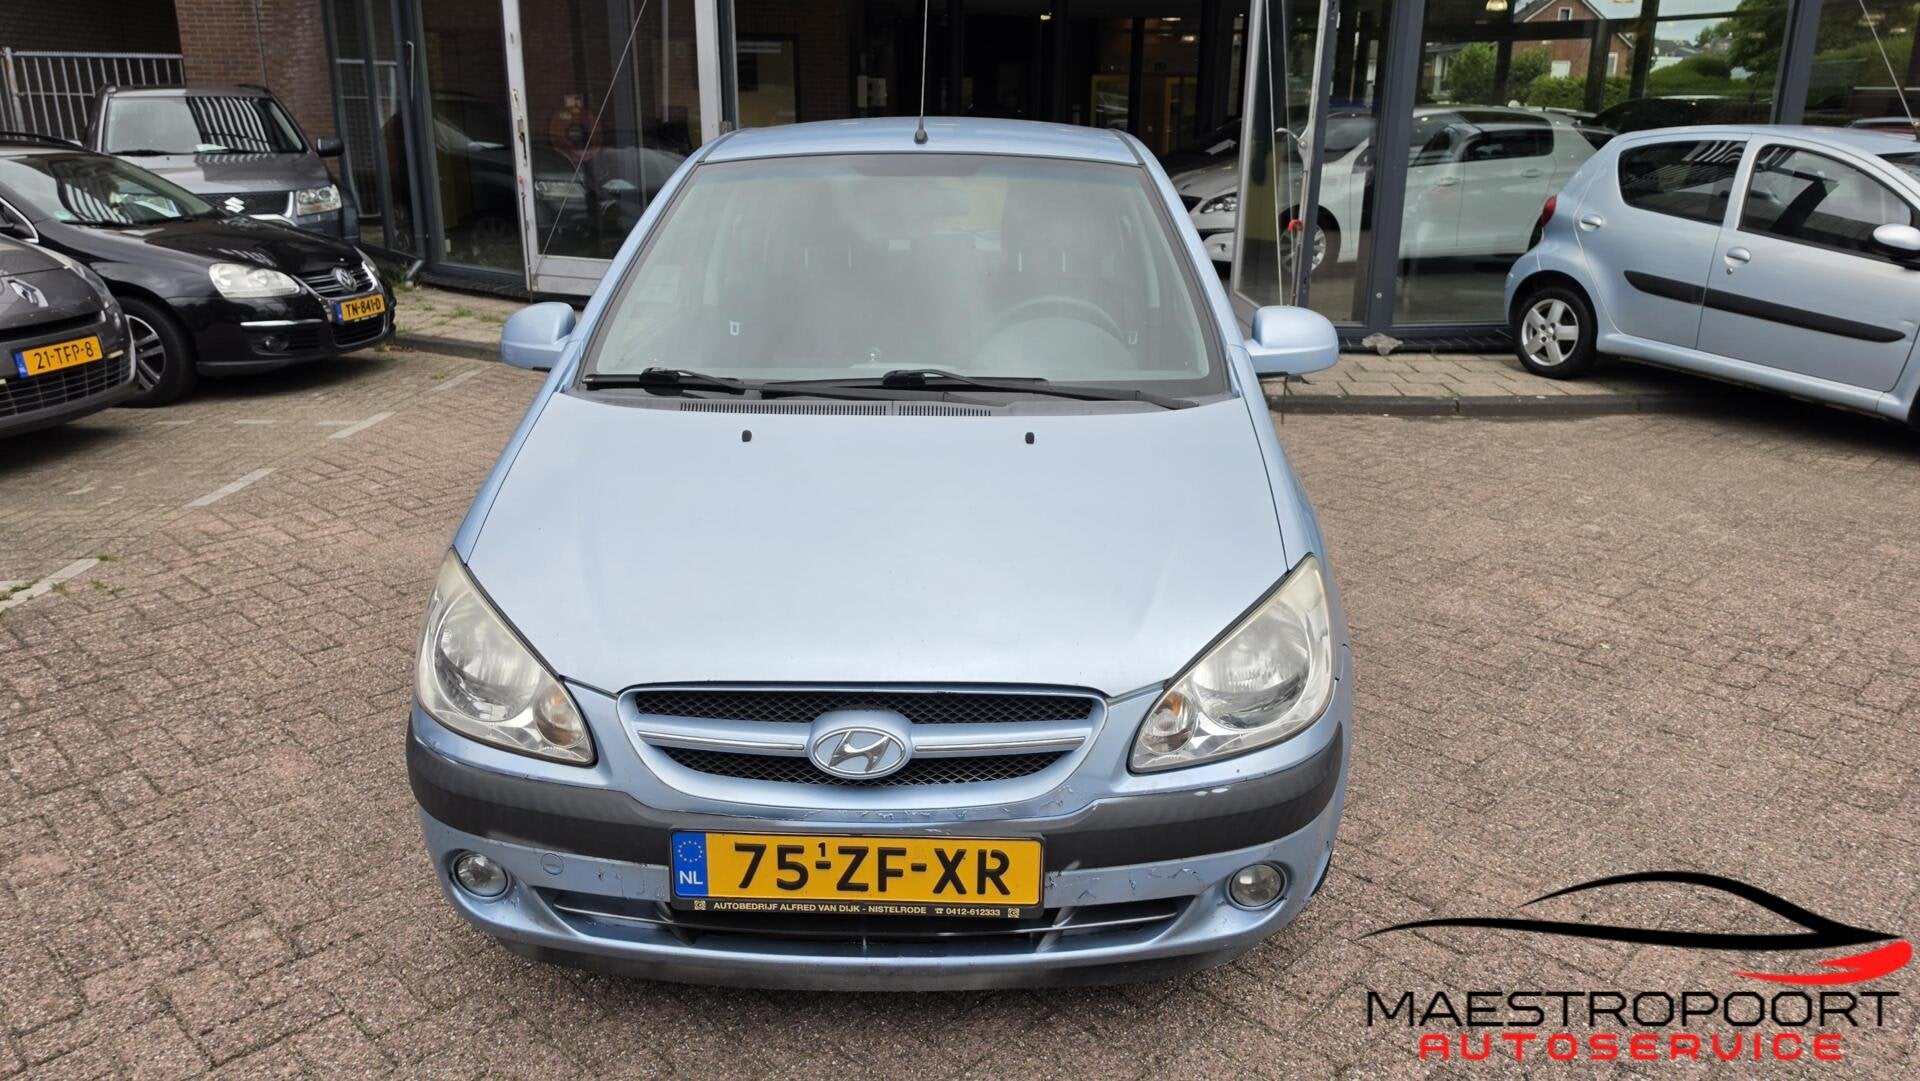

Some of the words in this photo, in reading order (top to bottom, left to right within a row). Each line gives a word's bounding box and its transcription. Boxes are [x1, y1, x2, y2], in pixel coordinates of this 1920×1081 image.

[34, 341, 94, 370] 21-TFP-8
[679, 870, 703, 885] NL
[713, 902, 778, 911] AUTOBEDRIJF
[779, 903, 816, 912] ALFRED
[817, 904, 837, 912] VAN
[838, 905, 860, 913] DIJK
[868, 906, 927, 914] NISTELRODE
[946, 907, 1001, 916] 0412-612333
